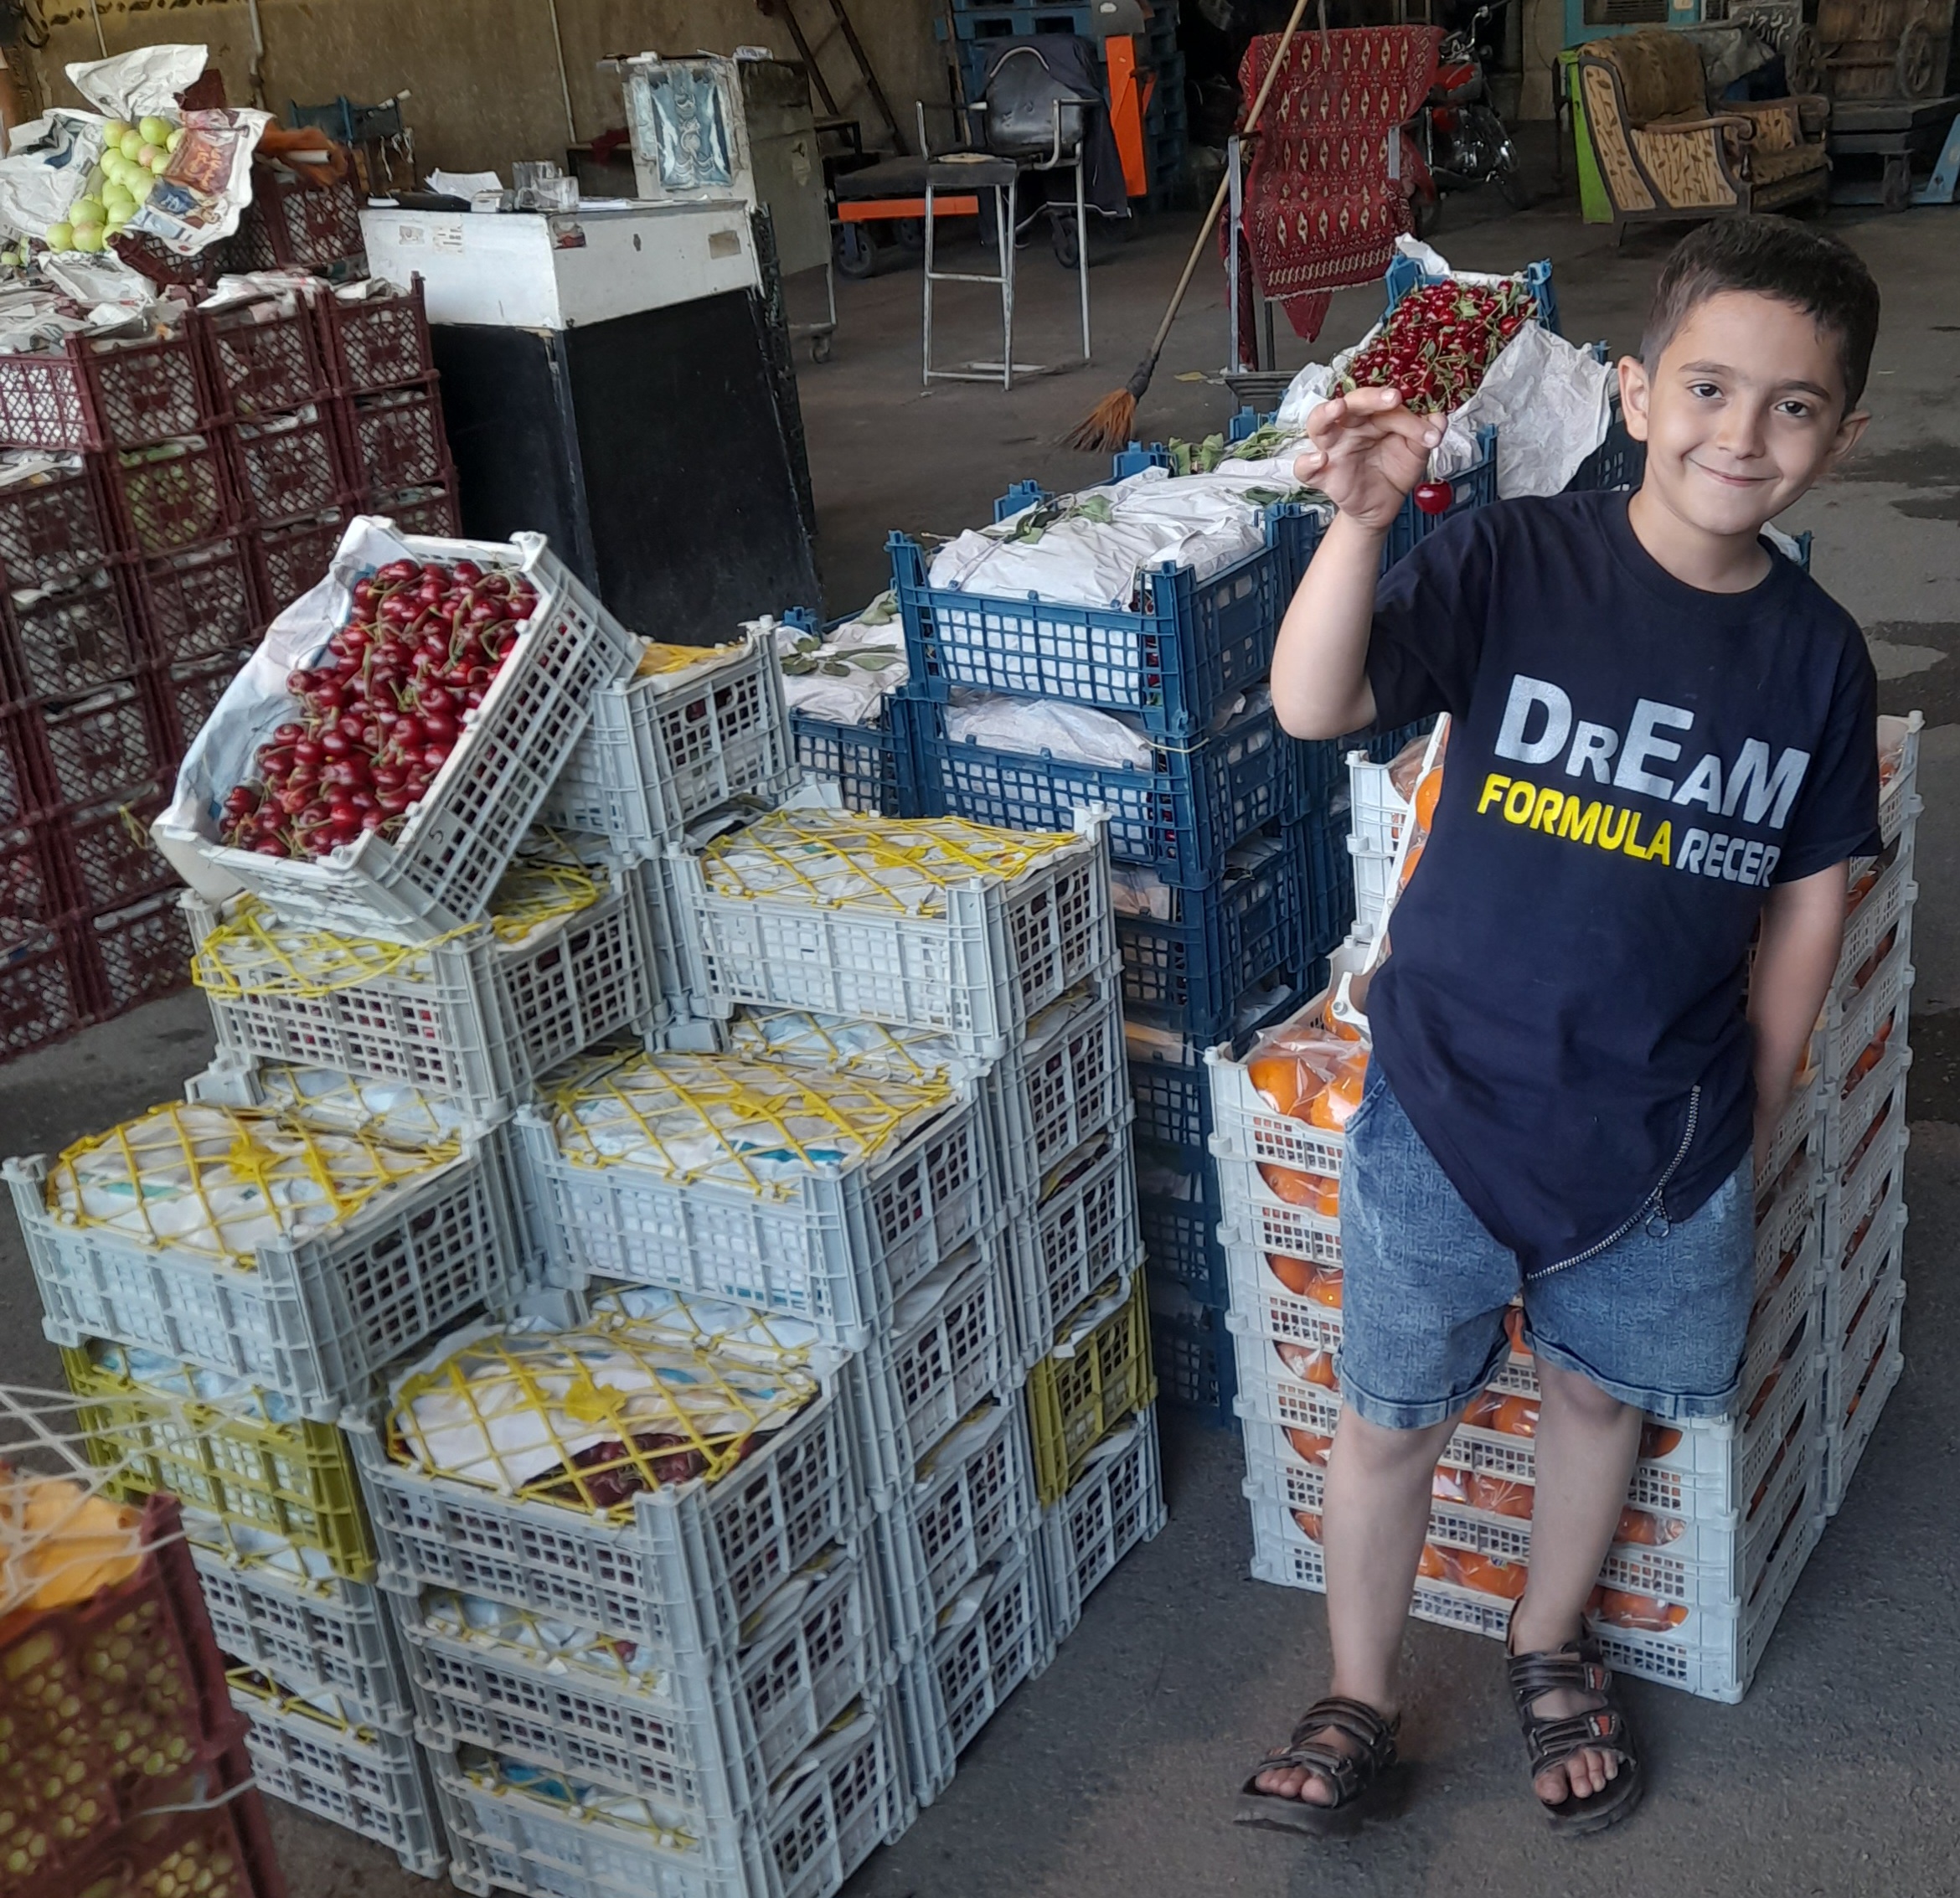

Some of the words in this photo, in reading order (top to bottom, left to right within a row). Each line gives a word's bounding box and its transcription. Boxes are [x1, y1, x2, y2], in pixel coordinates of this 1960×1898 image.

[1494, 673, 1810, 829] DREAM
[1477, 773, 1671, 867] FORMULA
[1675, 828, 1781, 889] RECER
